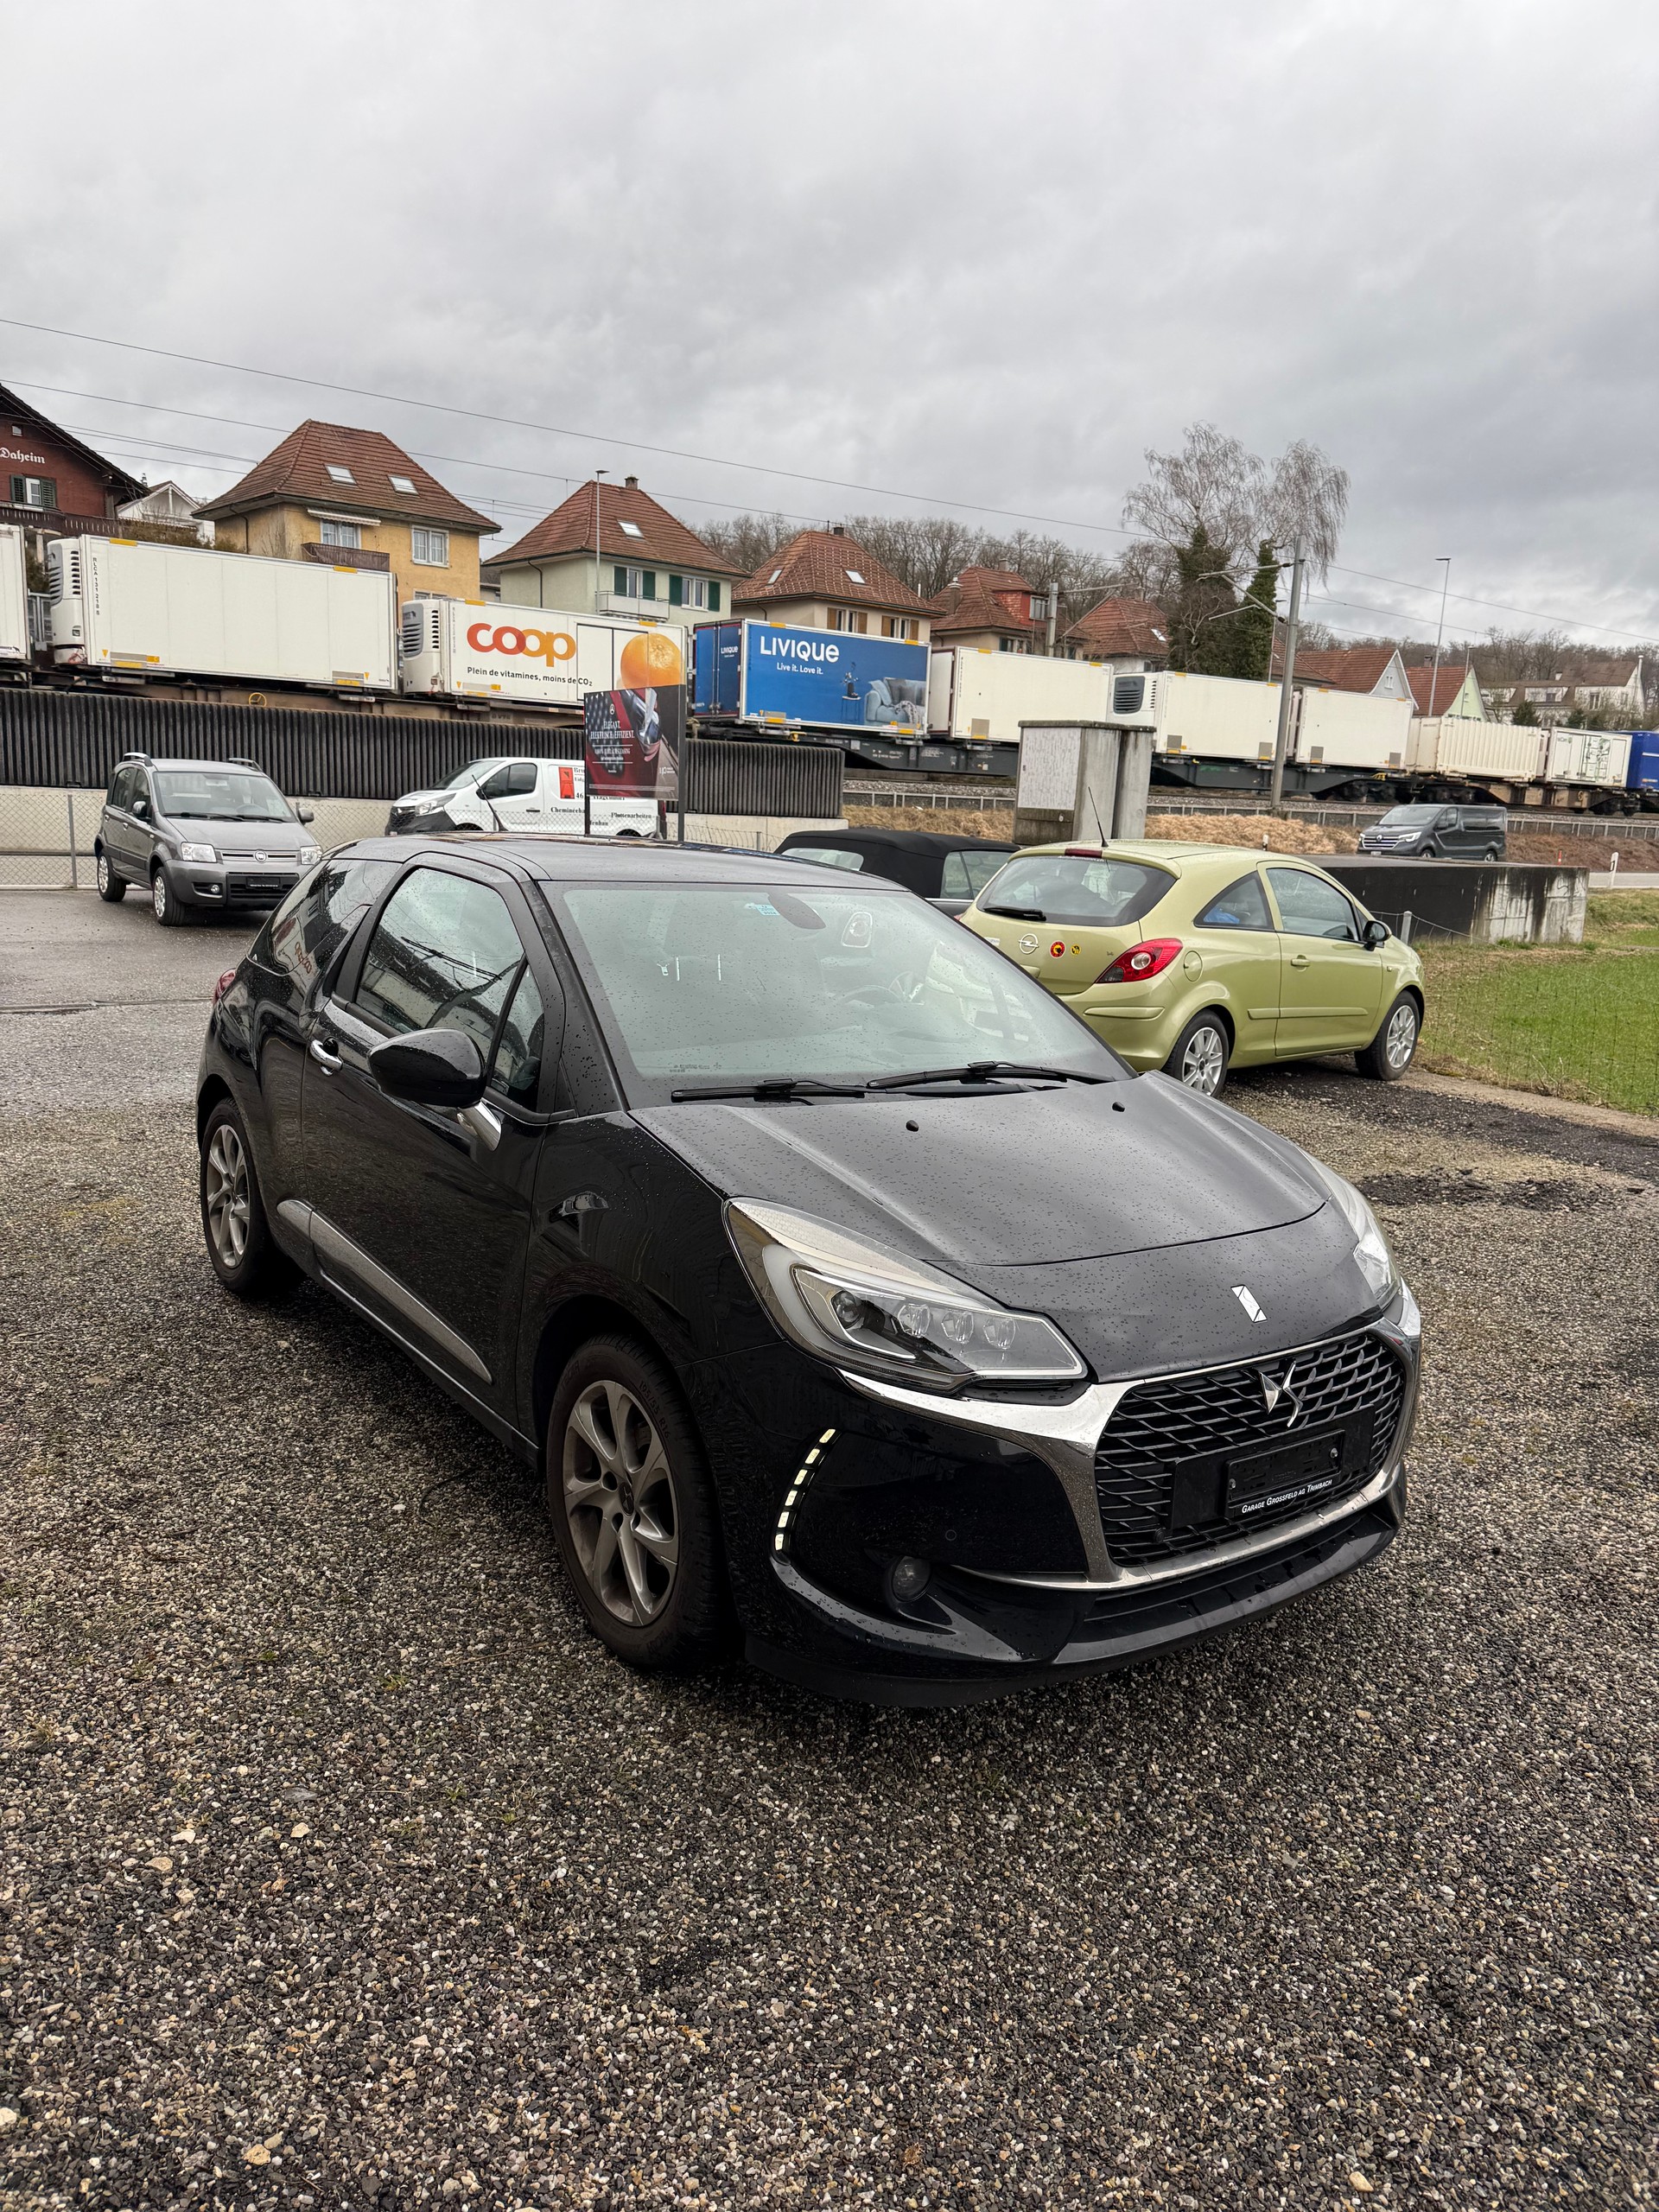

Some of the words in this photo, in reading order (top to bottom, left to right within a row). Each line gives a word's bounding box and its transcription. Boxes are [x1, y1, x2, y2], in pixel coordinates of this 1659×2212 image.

[0, 447, 46, 464] Daheim
[467, 622, 576, 668] coop
[467, 666, 487, 676] Plein
[500, 671, 541, 682] vitamines,
[543, 675, 566, 683] moins
[777, 662, 791, 671] Live
[799, 665, 816, 674] Love
[1242, 1501, 1265, 1514] GARAGE
[1267, 1491, 1298, 1506] GROSSFELD
[1307, 1479, 1332, 1493] TRIMBACH
